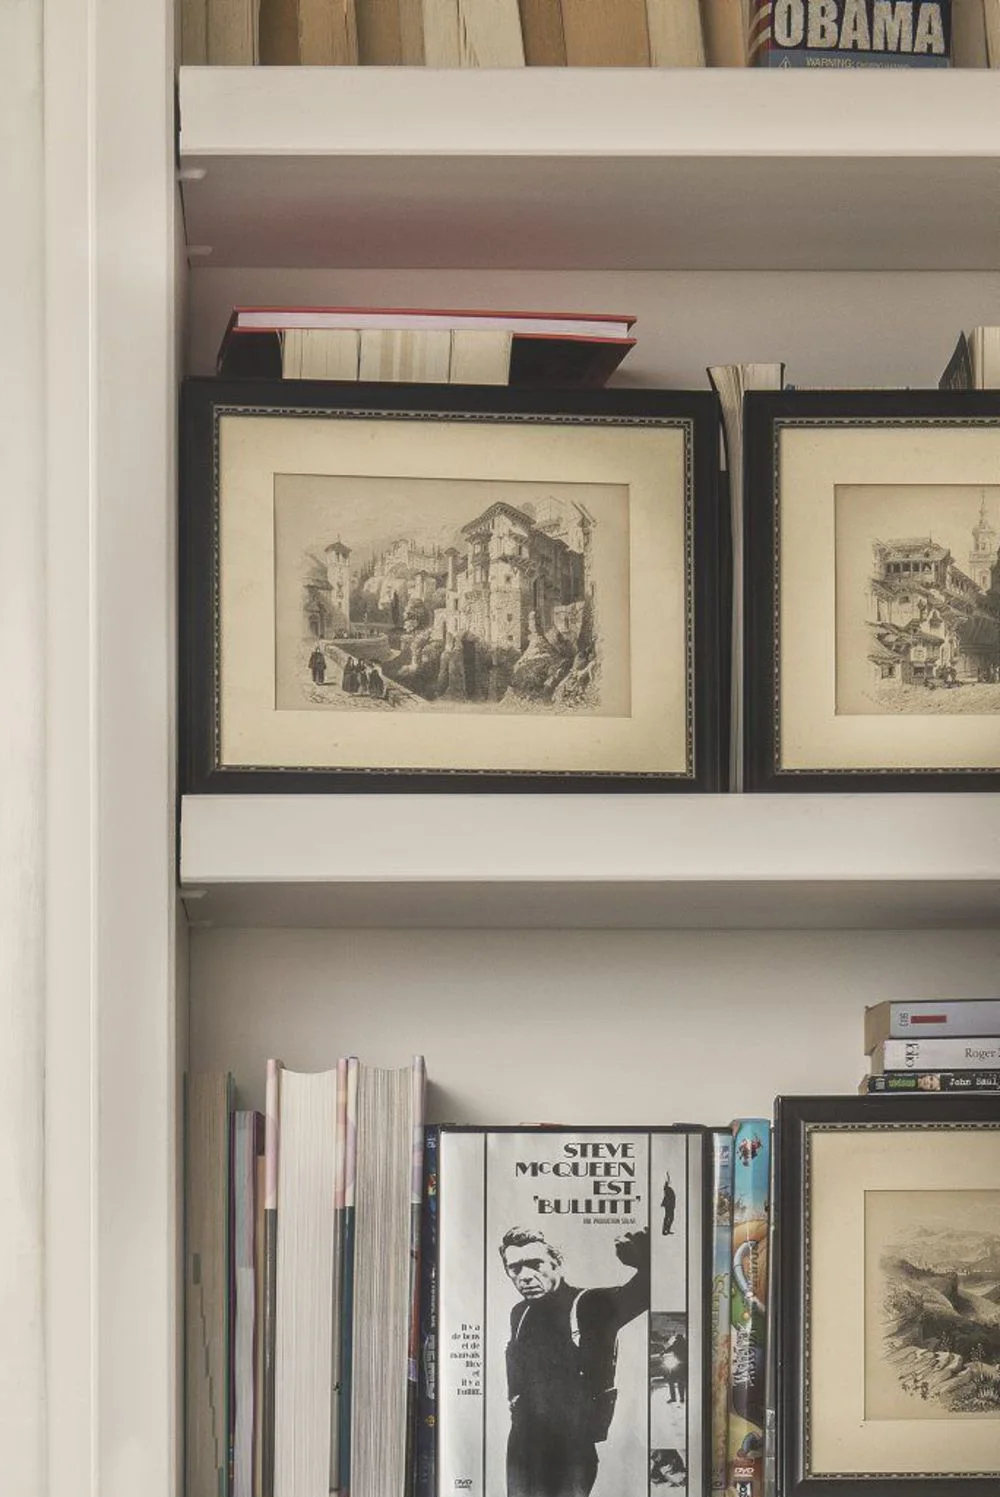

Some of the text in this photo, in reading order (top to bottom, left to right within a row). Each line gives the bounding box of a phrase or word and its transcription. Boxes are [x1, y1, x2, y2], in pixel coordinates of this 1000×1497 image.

[774, 0, 945, 54] OBAMA
[964, 1047, 995, 1061] Roger
[950, 1076, 998, 1086] John Saul
[563, 1142, 636, 1158] STEVE
[515, 1161, 636, 1177] McQUEEN
[593, 1180, 636, 1195] EST
[734, 1467, 755, 1475] DVD
